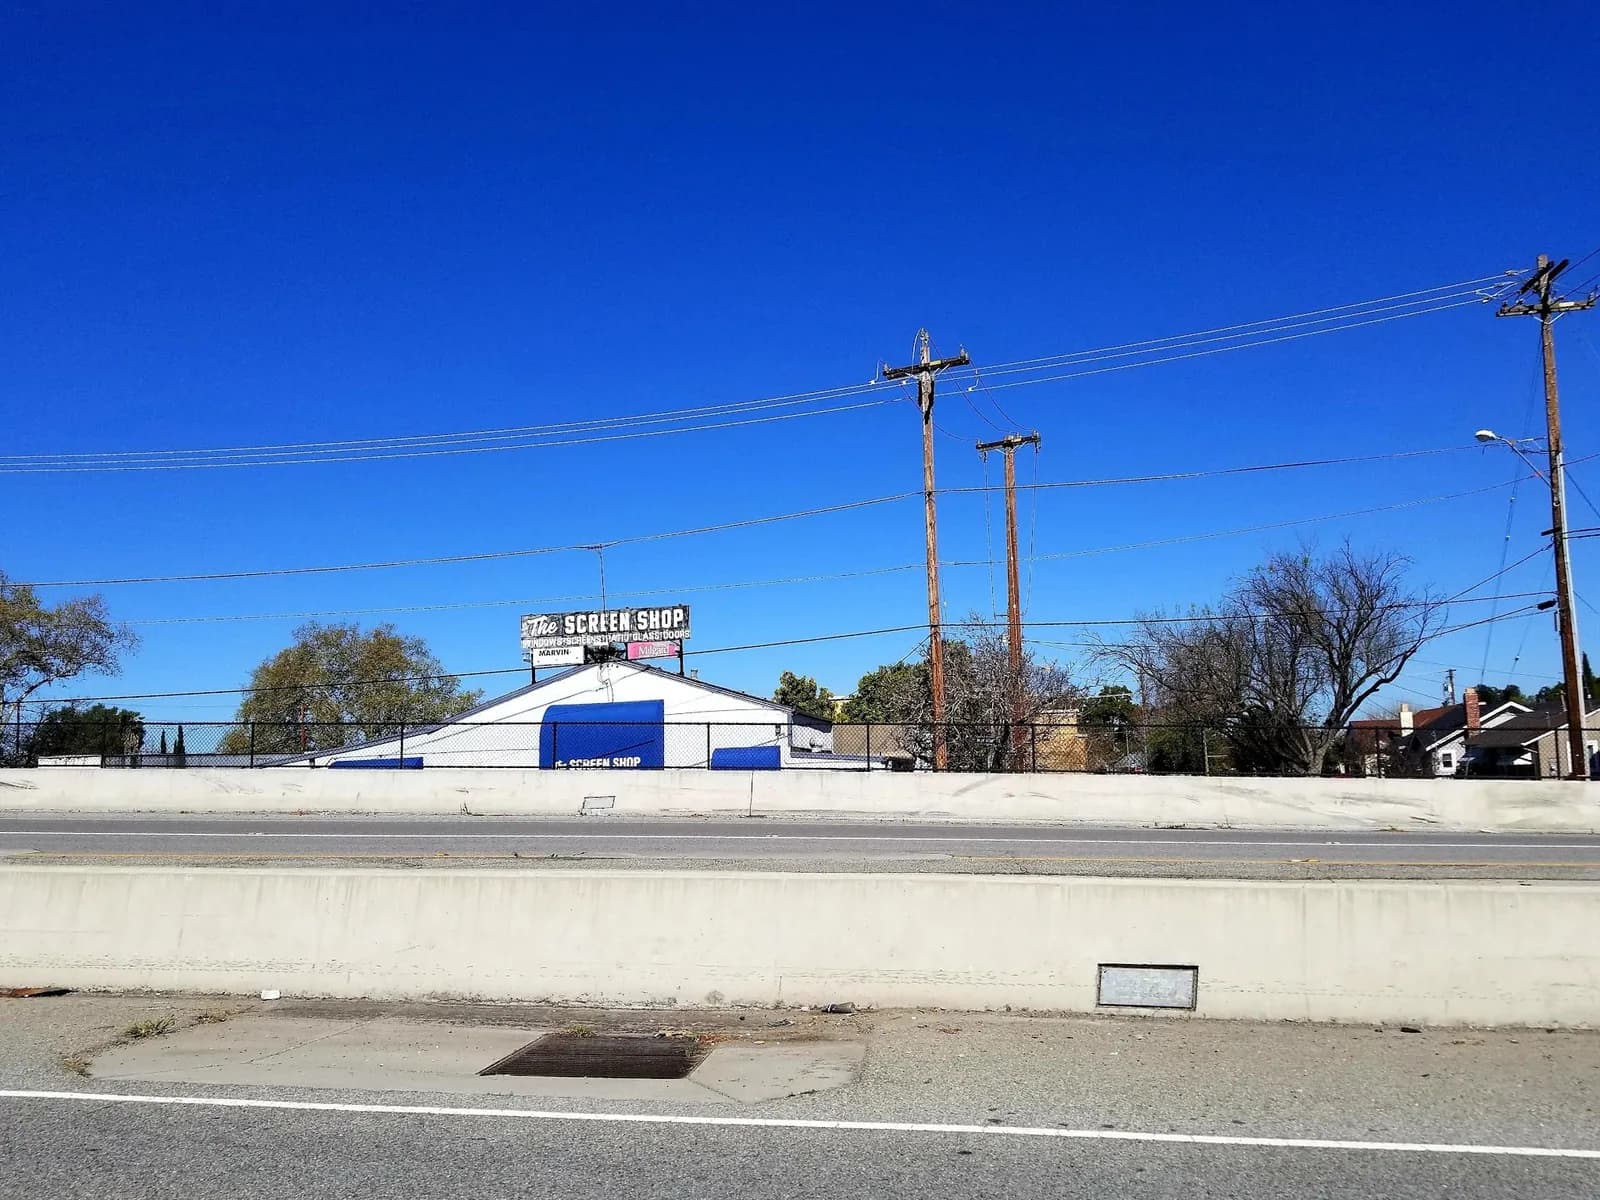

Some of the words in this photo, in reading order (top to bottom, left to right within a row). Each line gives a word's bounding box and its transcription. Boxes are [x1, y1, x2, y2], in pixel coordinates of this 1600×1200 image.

[527, 615, 558, 636] The
[564, 612, 630, 634] SCREEN
[637, 609, 684, 631] SHOP
[538, 649, 570, 657] MARVIN
[612, 756, 641, 767] SHOP
